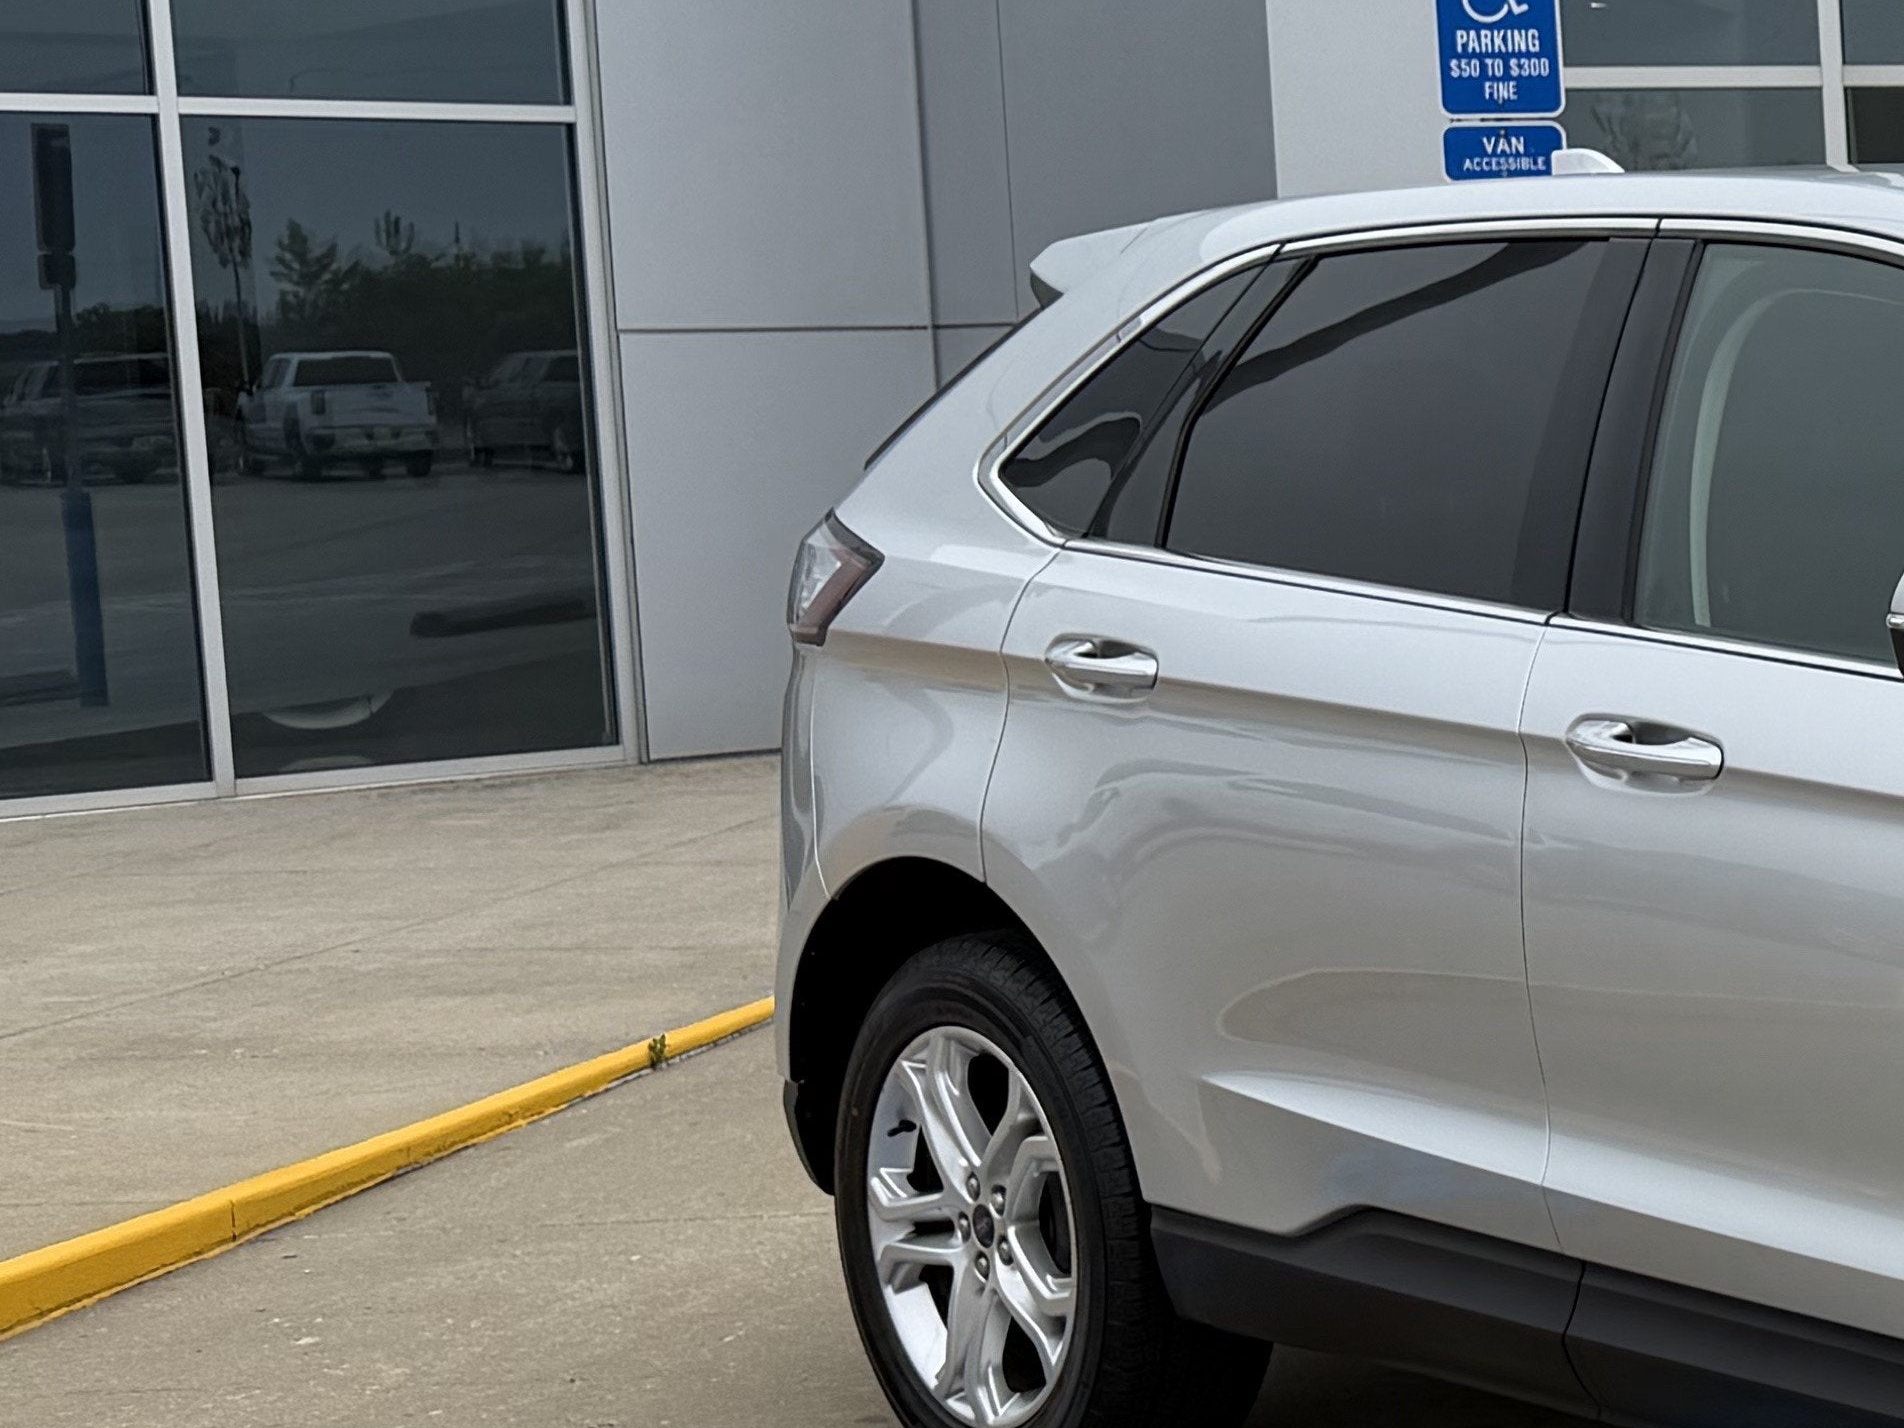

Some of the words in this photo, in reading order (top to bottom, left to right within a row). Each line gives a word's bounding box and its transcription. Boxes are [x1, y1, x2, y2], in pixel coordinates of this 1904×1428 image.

[1456, 29, 1540, 53] PARKING
[1450, 59, 1480, 78] $50
[1485, 59, 1503, 77] TO
[1509, 58, 1549, 77] $300
[1484, 81, 1517, 100] FINE
[1482, 136, 1524, 154] VAN
[1463, 156, 1546, 172] ACCESSIBLE
